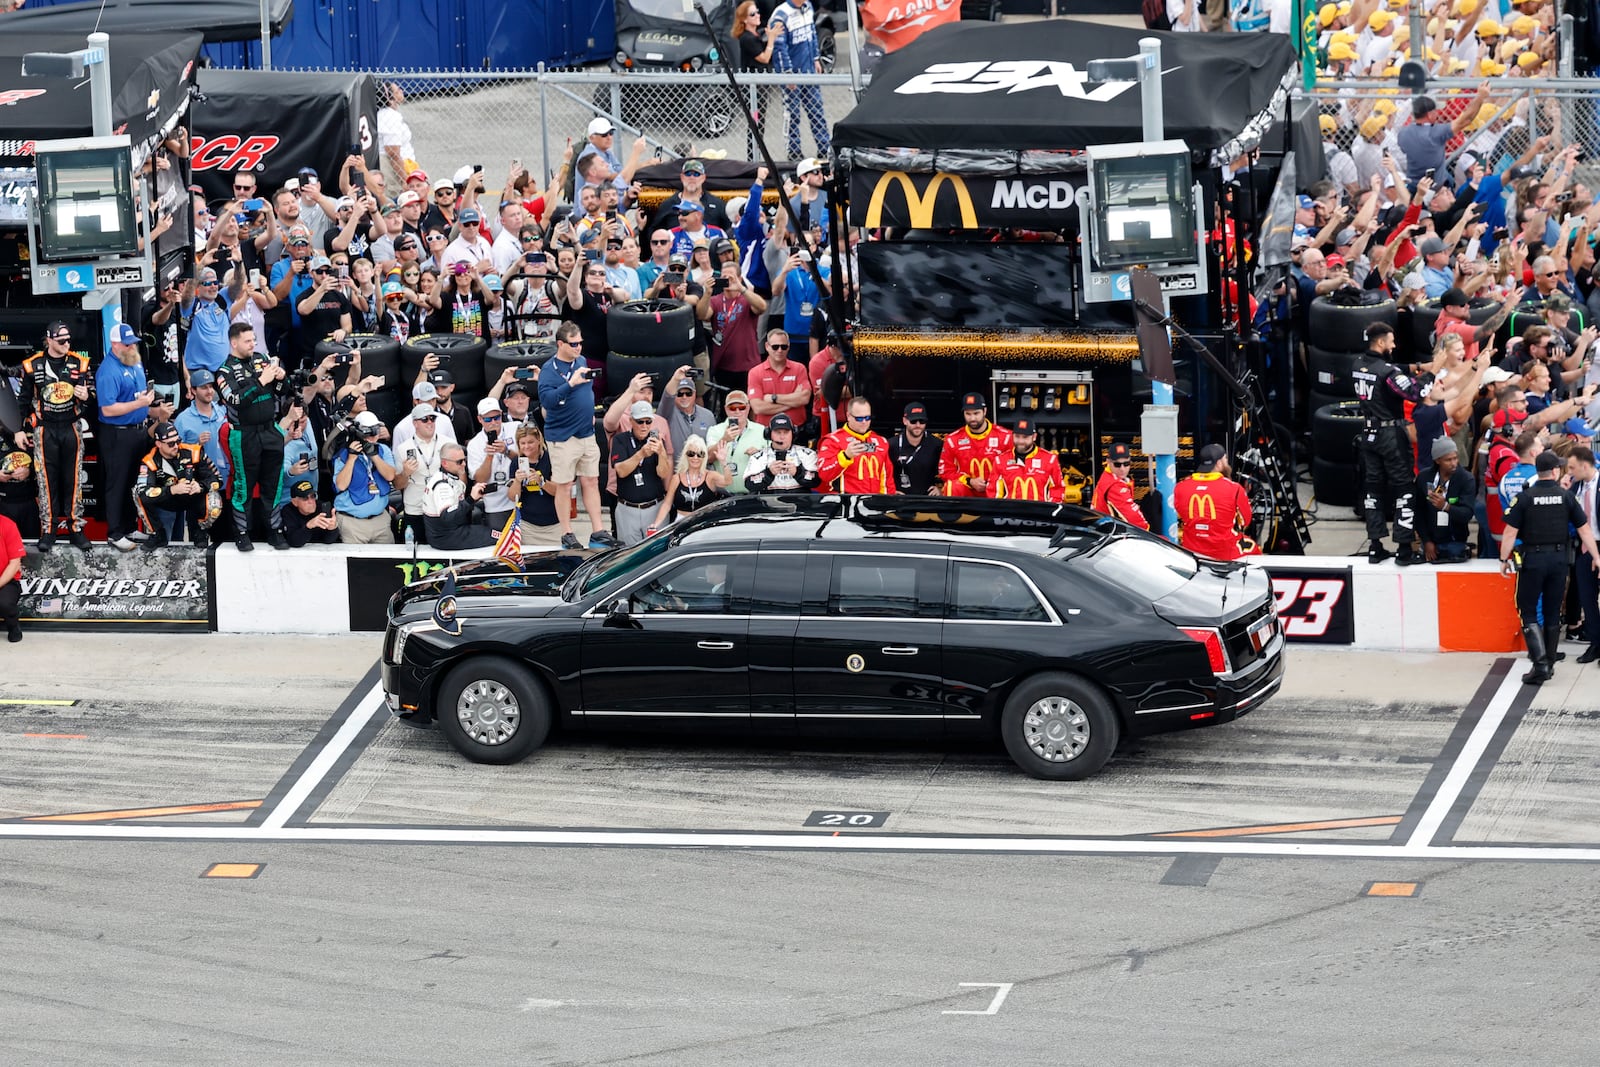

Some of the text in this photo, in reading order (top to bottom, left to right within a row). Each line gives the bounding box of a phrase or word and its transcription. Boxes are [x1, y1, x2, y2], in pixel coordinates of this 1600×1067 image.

[637, 32, 687, 42] LEGACY
[359, 115, 373, 150] 3
[192, 135, 279, 171] CR
[1533, 495, 1563, 506] POLICE
[63, 600, 164, 617] The American Legend
[1271, 578, 1345, 637] 23
[818, 814, 874, 825] 20
